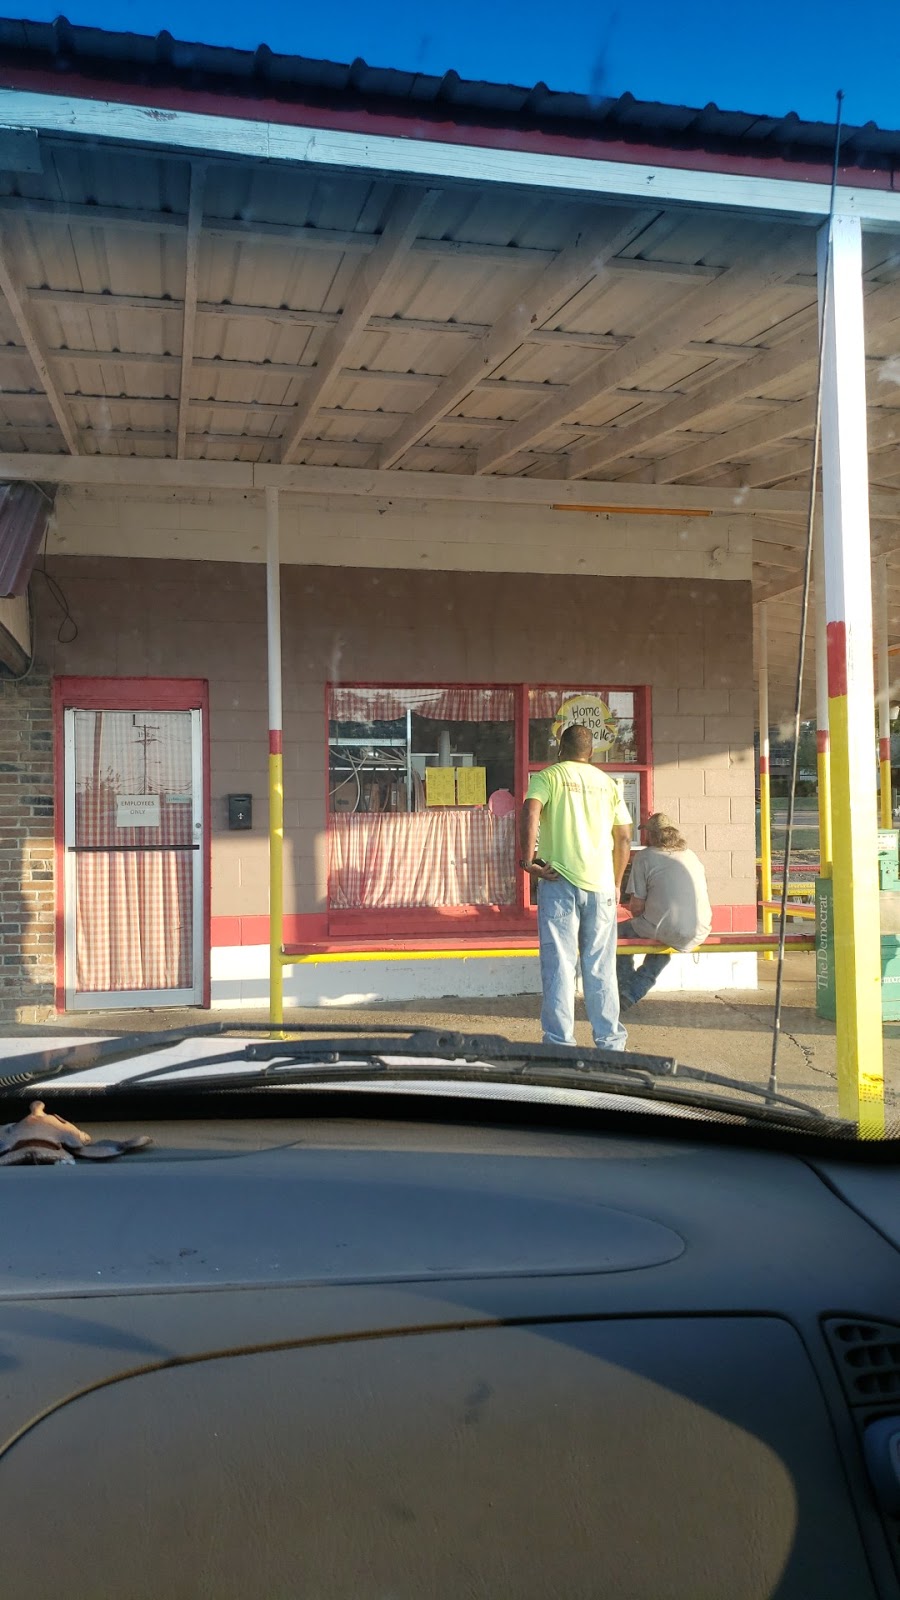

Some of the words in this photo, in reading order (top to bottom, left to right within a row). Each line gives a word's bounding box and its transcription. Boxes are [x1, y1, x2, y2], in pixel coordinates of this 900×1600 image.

[571, 705, 600, 718] Home
[580, 717, 601, 728] the
[817, 894, 828, 961] Democrat
[816, 963, 829, 990] The
